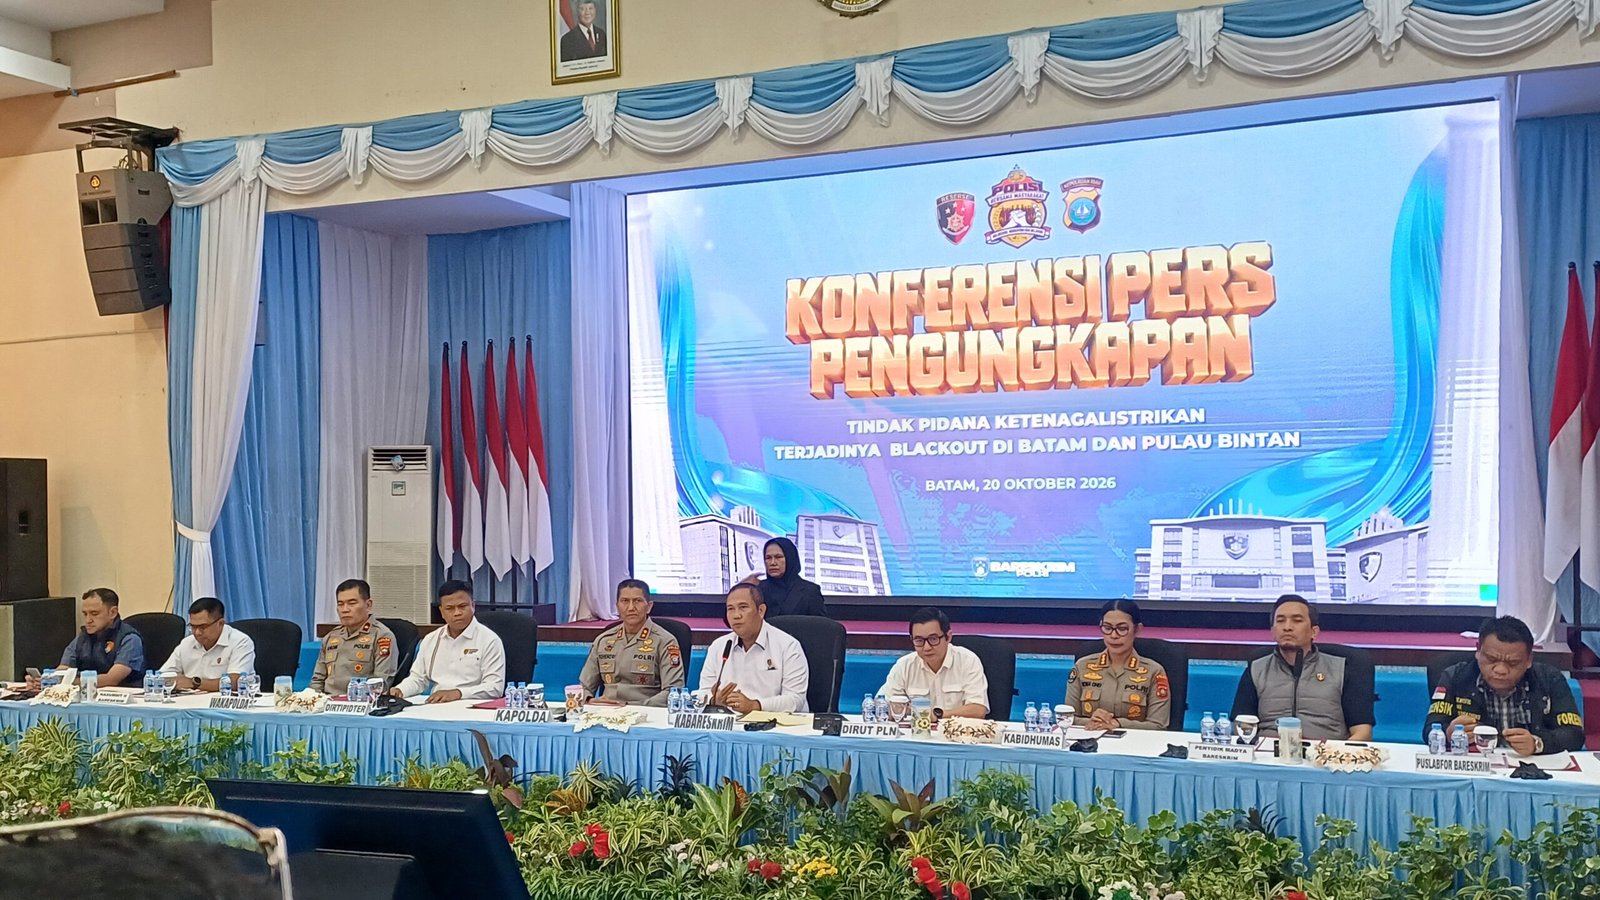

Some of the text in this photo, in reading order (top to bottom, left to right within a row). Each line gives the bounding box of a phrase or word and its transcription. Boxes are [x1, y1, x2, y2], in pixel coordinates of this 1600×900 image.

[992, 181, 1043, 196] POLISI
[786, 240, 1277, 344] KONFERENSI PERS
[810, 313, 1254, 400] PENGUNGKAPAN
[847, 408, 1206, 434] TINDAK PIDANA KETENAGALISTRIKAN
[774, 431, 1301, 460] TERJADINYA BLACKOUT DI BATAM DAN PULAU BINTAN
[925, 476, 1117, 492] BATAM, 20 OKTOBER 2026
[1124, 684, 1149, 692] POLRI
[209, 697, 249, 710] WAKAPOLDA
[325, 704, 367, 713] DIRTIPIDTER
[1428, 701, 1453, 716] ENSIK
[495, 709, 547, 723] KAPOLDA
[1556, 712, 1584, 727] FORE
[842, 724, 897, 736] DIRUT PLN
[1003, 733, 1061, 746] KABIDHUMAS
[1416, 758, 1491, 772] PUSLABFOR BARESKRIM
